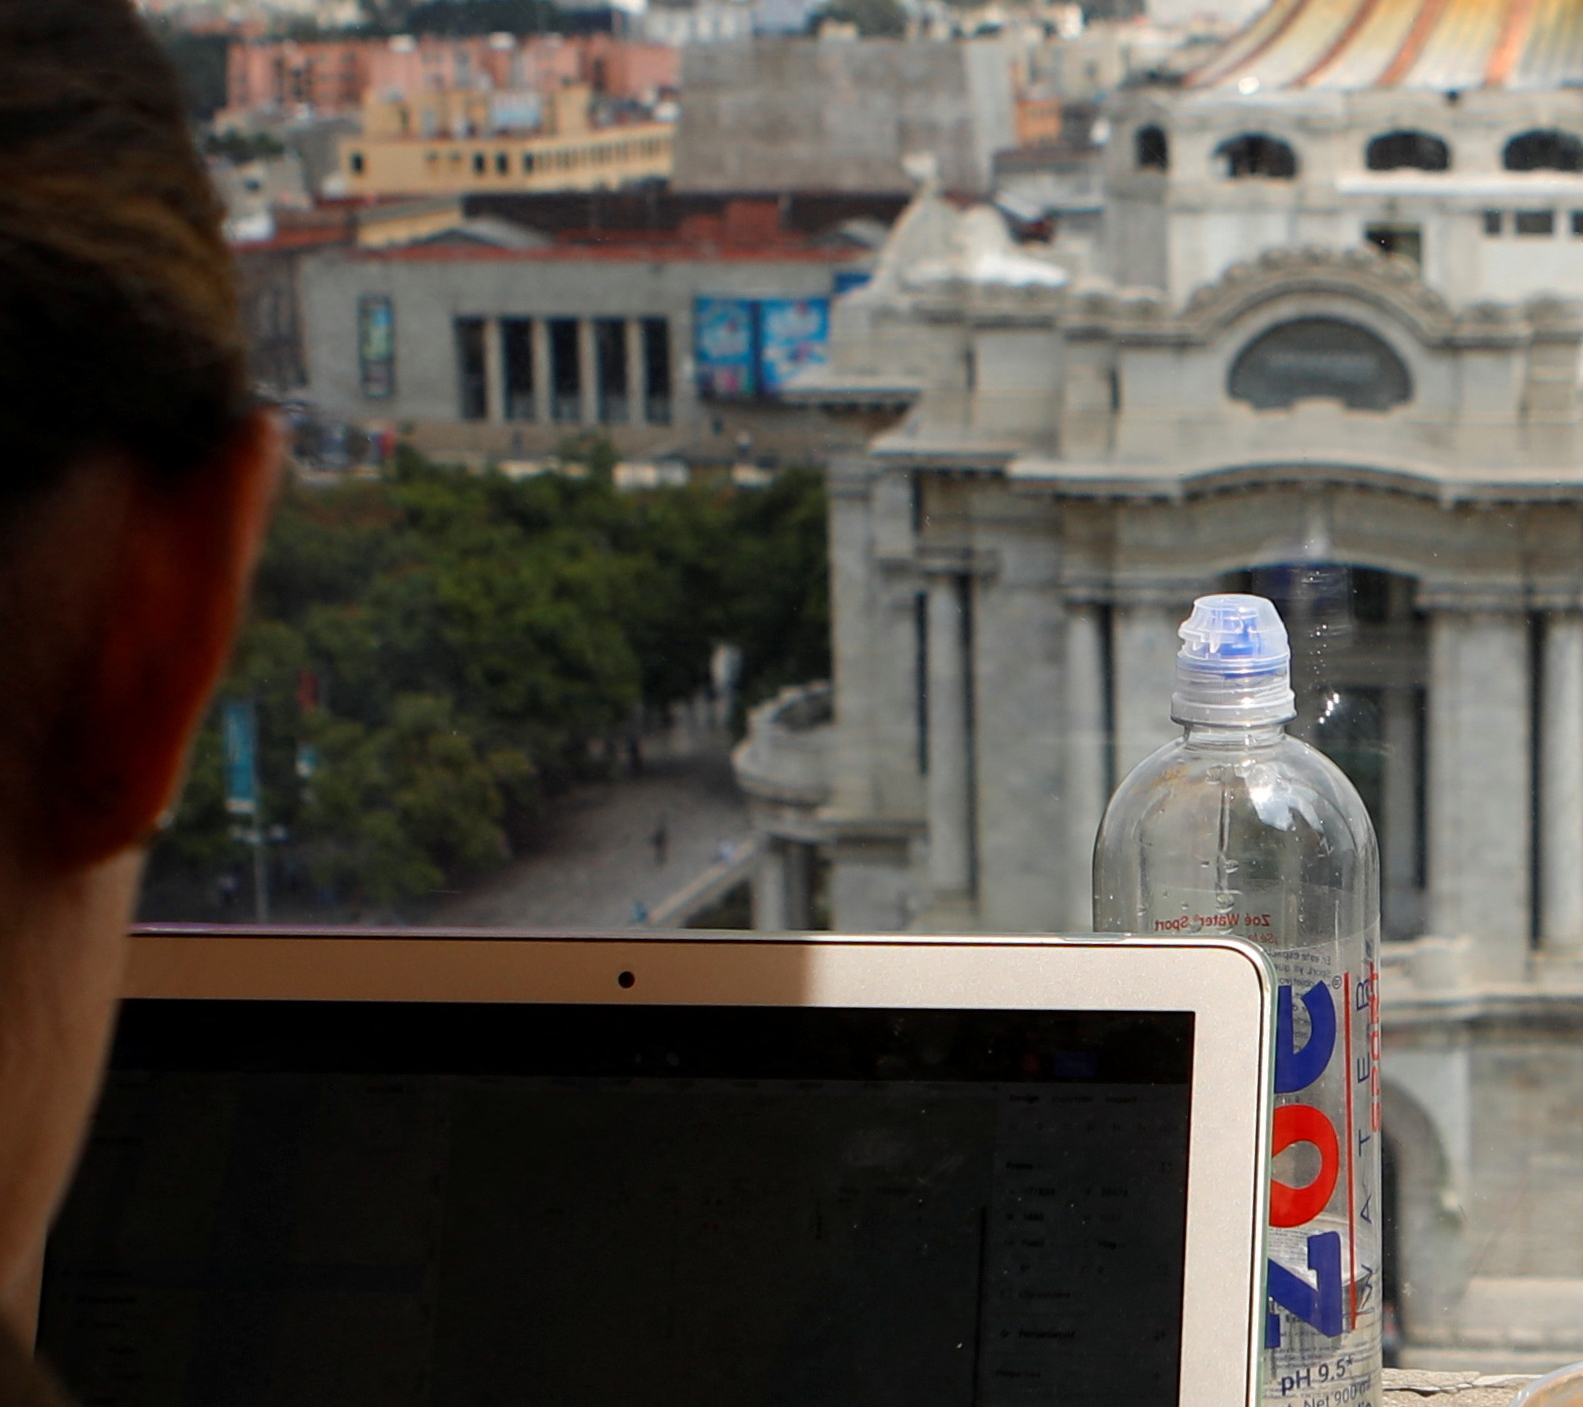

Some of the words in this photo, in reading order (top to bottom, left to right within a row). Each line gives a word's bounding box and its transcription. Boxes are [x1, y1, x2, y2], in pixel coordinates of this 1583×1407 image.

[1356, 978, 1374, 1310] WATER
[1281, 1367, 1311, 1396] pH
[1334, 1384, 1358, 1406] 900
